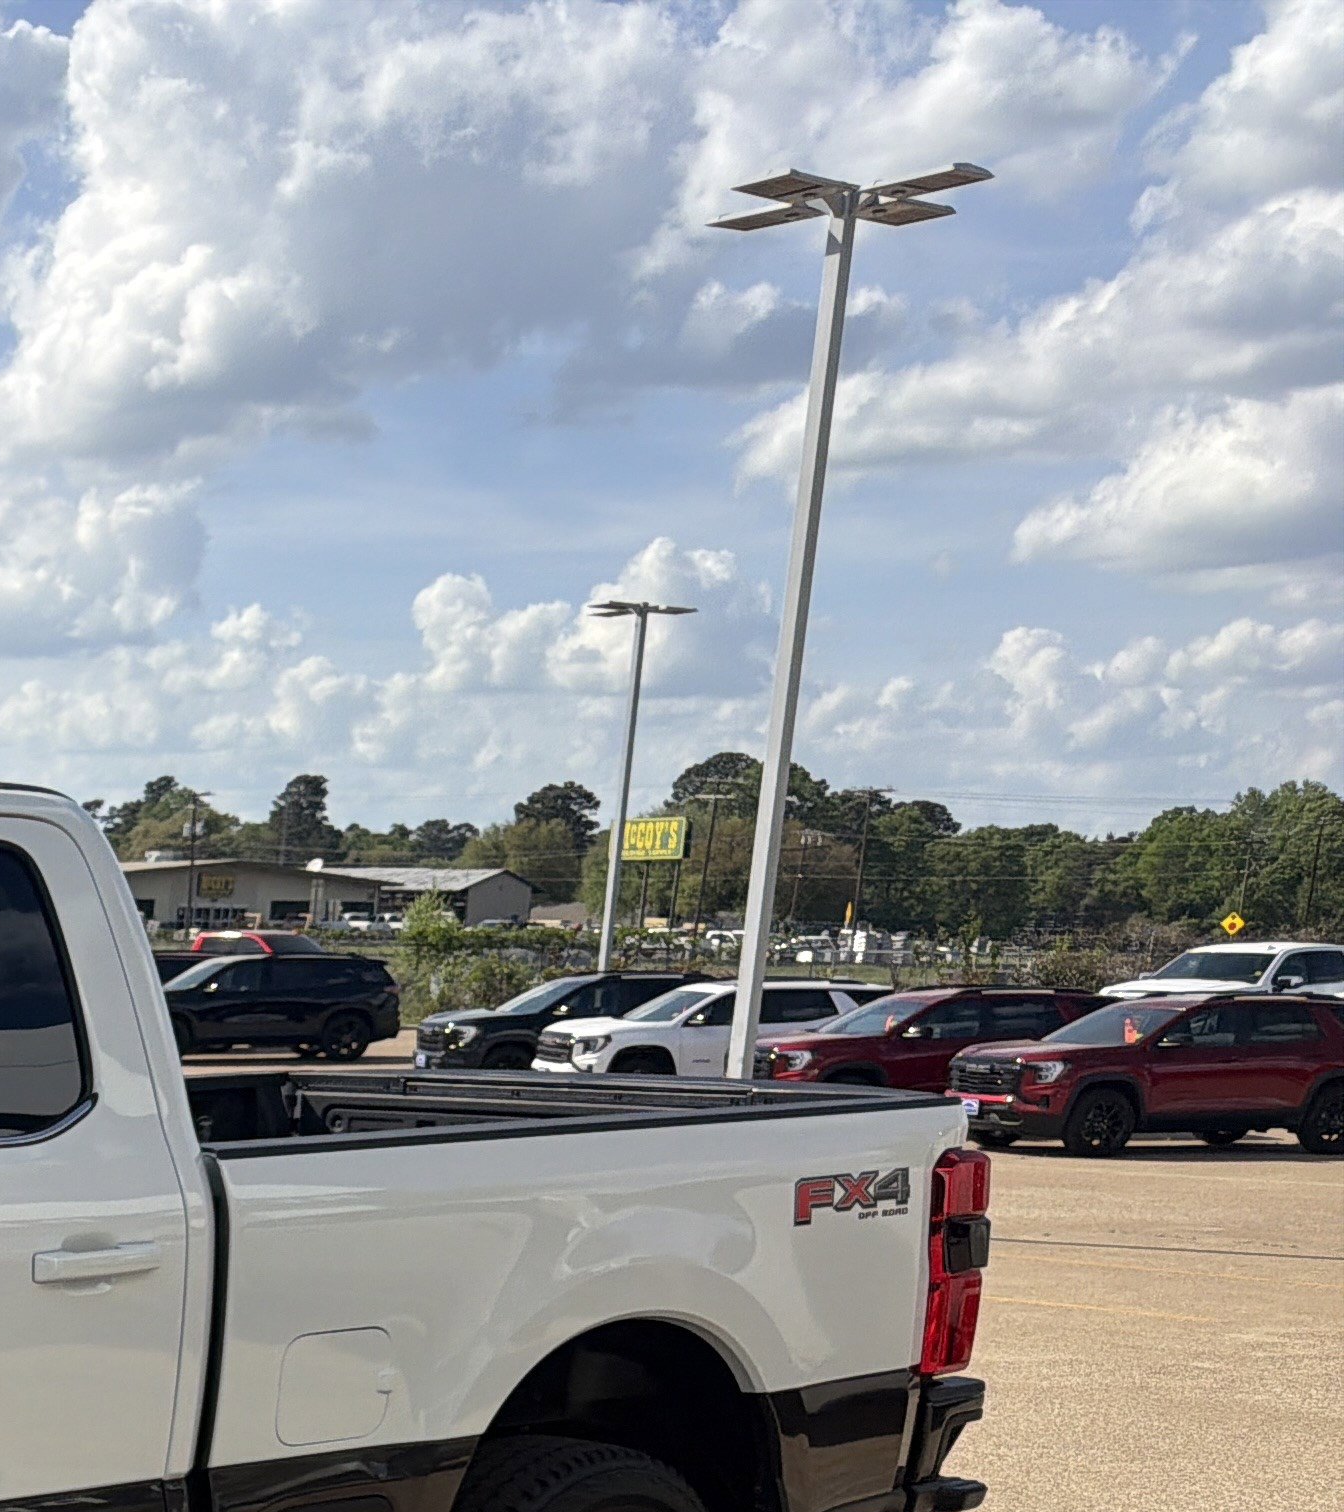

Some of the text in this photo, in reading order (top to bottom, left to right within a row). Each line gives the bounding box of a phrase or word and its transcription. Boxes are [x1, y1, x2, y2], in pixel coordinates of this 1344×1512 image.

[794, 1167, 910, 1227] FX4
[857, 1206, 909, 1220] OFF ROAD
